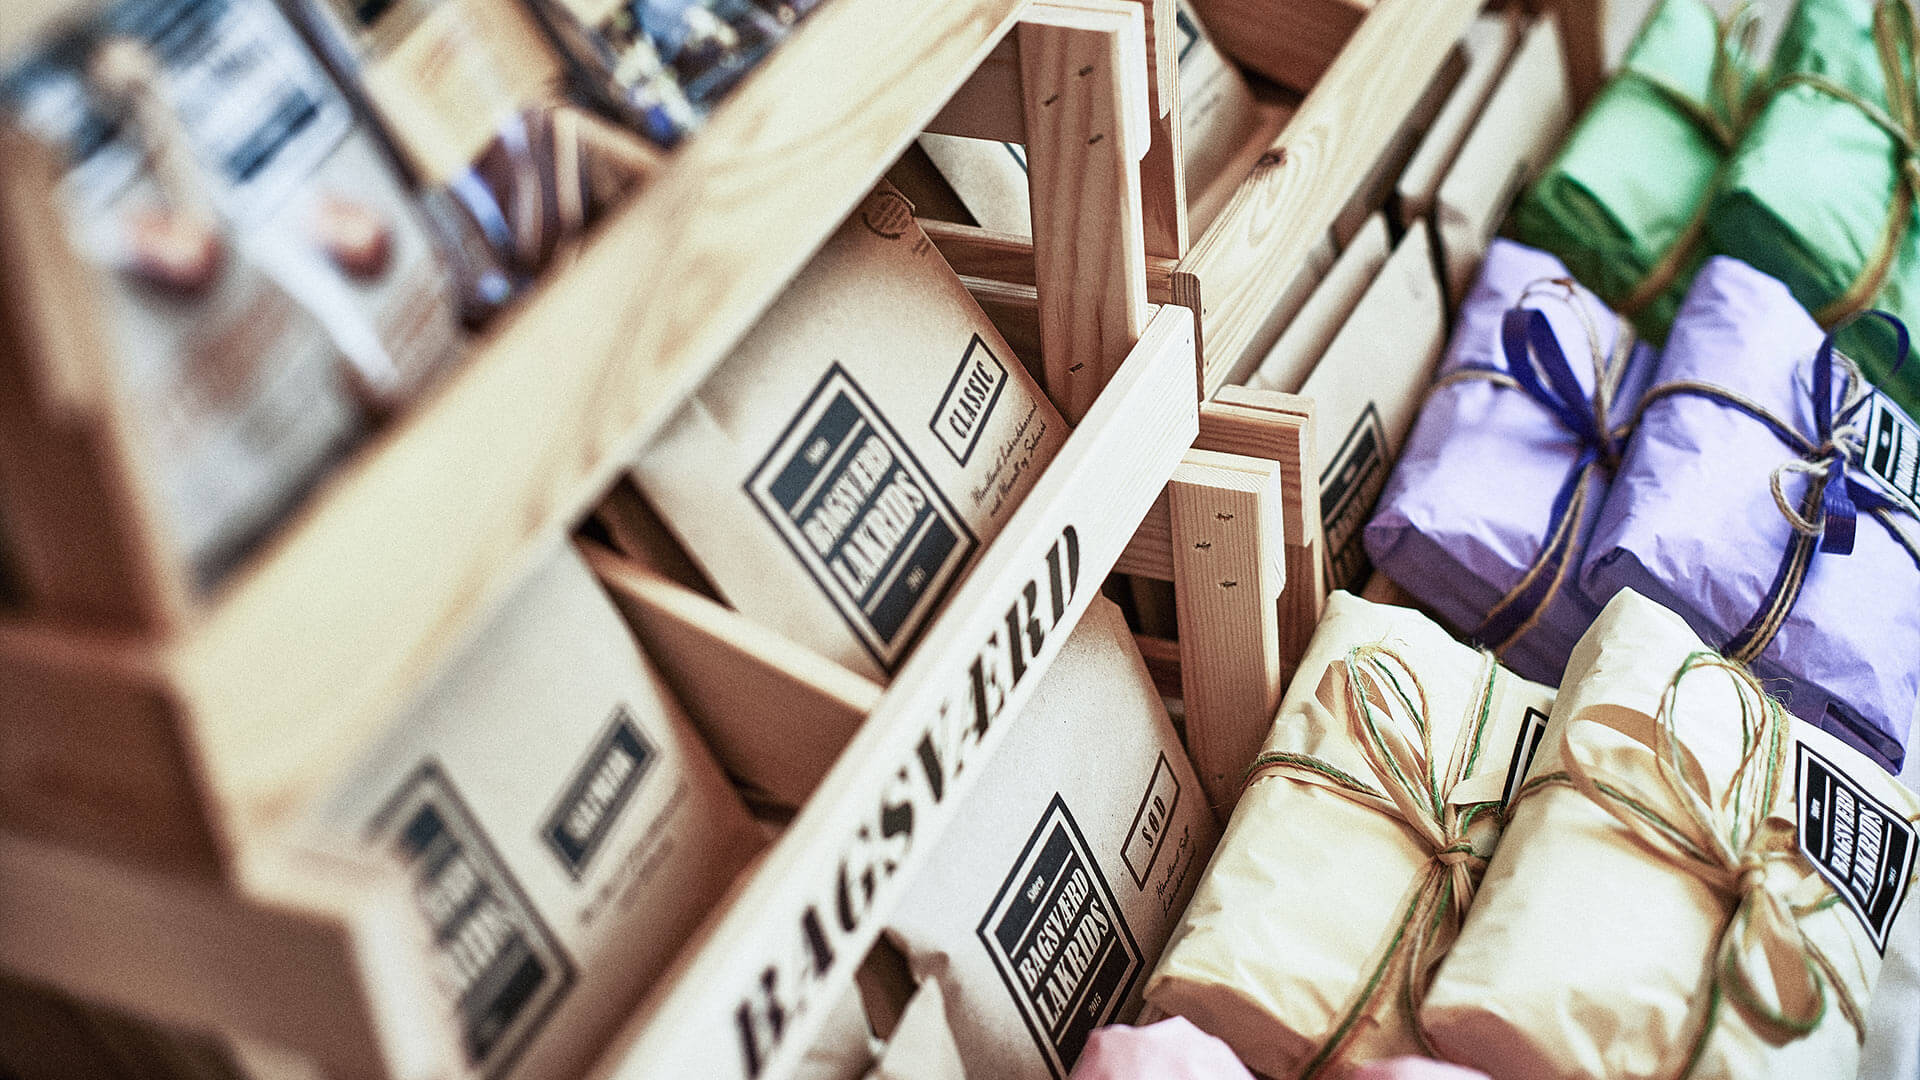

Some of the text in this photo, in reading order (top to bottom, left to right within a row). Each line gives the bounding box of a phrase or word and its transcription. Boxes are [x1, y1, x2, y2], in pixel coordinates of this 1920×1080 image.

[949, 360, 995, 440] CLASSIC
[831, 468, 926, 600] LAKRIDS
[734, 524, 1081, 1080] BAGSVÆRD
[1141, 795, 1167, 849] SØD
[1829, 785, 1855, 879] BAGSVÆRD
[1852, 800, 1883, 904] LAKRIDS
[1017, 867, 1090, 992] BAGSVÆRD
[1035, 900, 1110, 1033] LAKRIDS
[1087, 992, 1103, 1017] 2015
